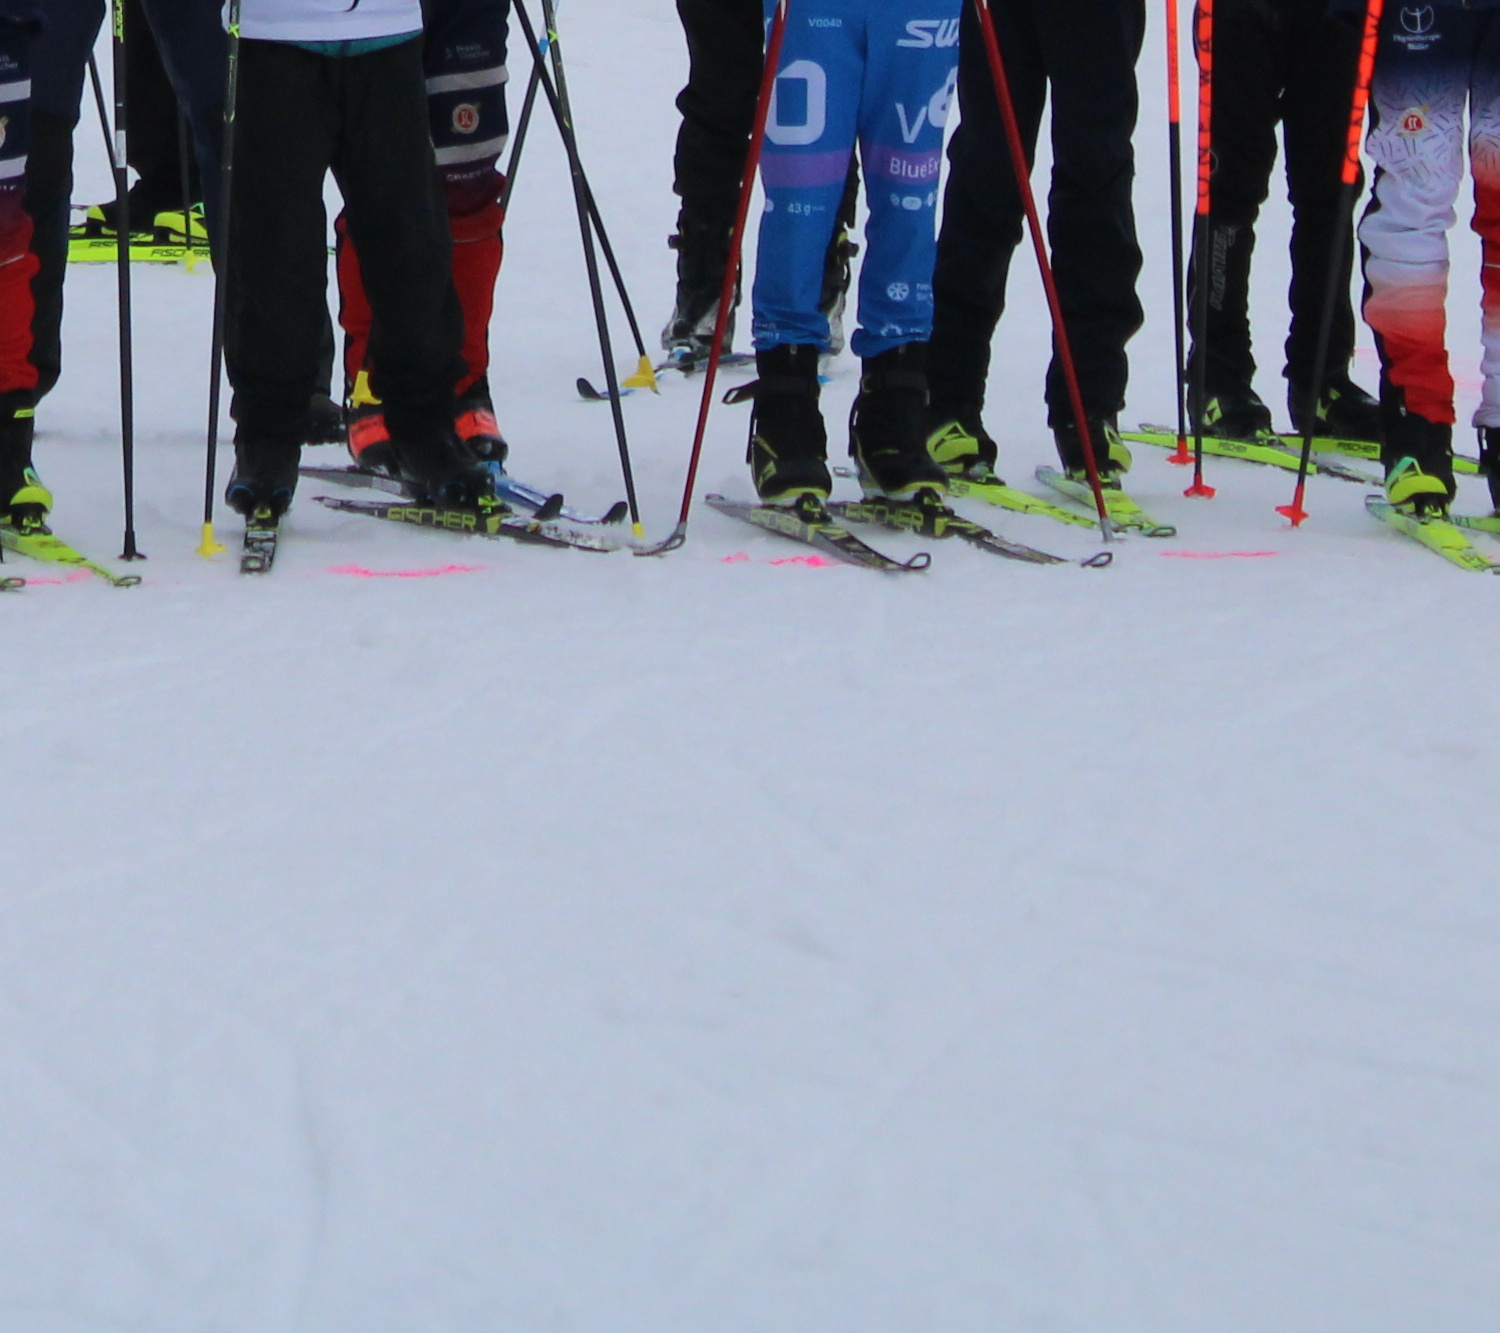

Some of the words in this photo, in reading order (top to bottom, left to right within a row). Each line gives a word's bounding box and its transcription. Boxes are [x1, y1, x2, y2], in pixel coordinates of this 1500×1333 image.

[150, 248, 212, 258] FISCER
[1337, 442, 1379, 454] FISCHER
[387, 507, 477, 532] FISCHER
